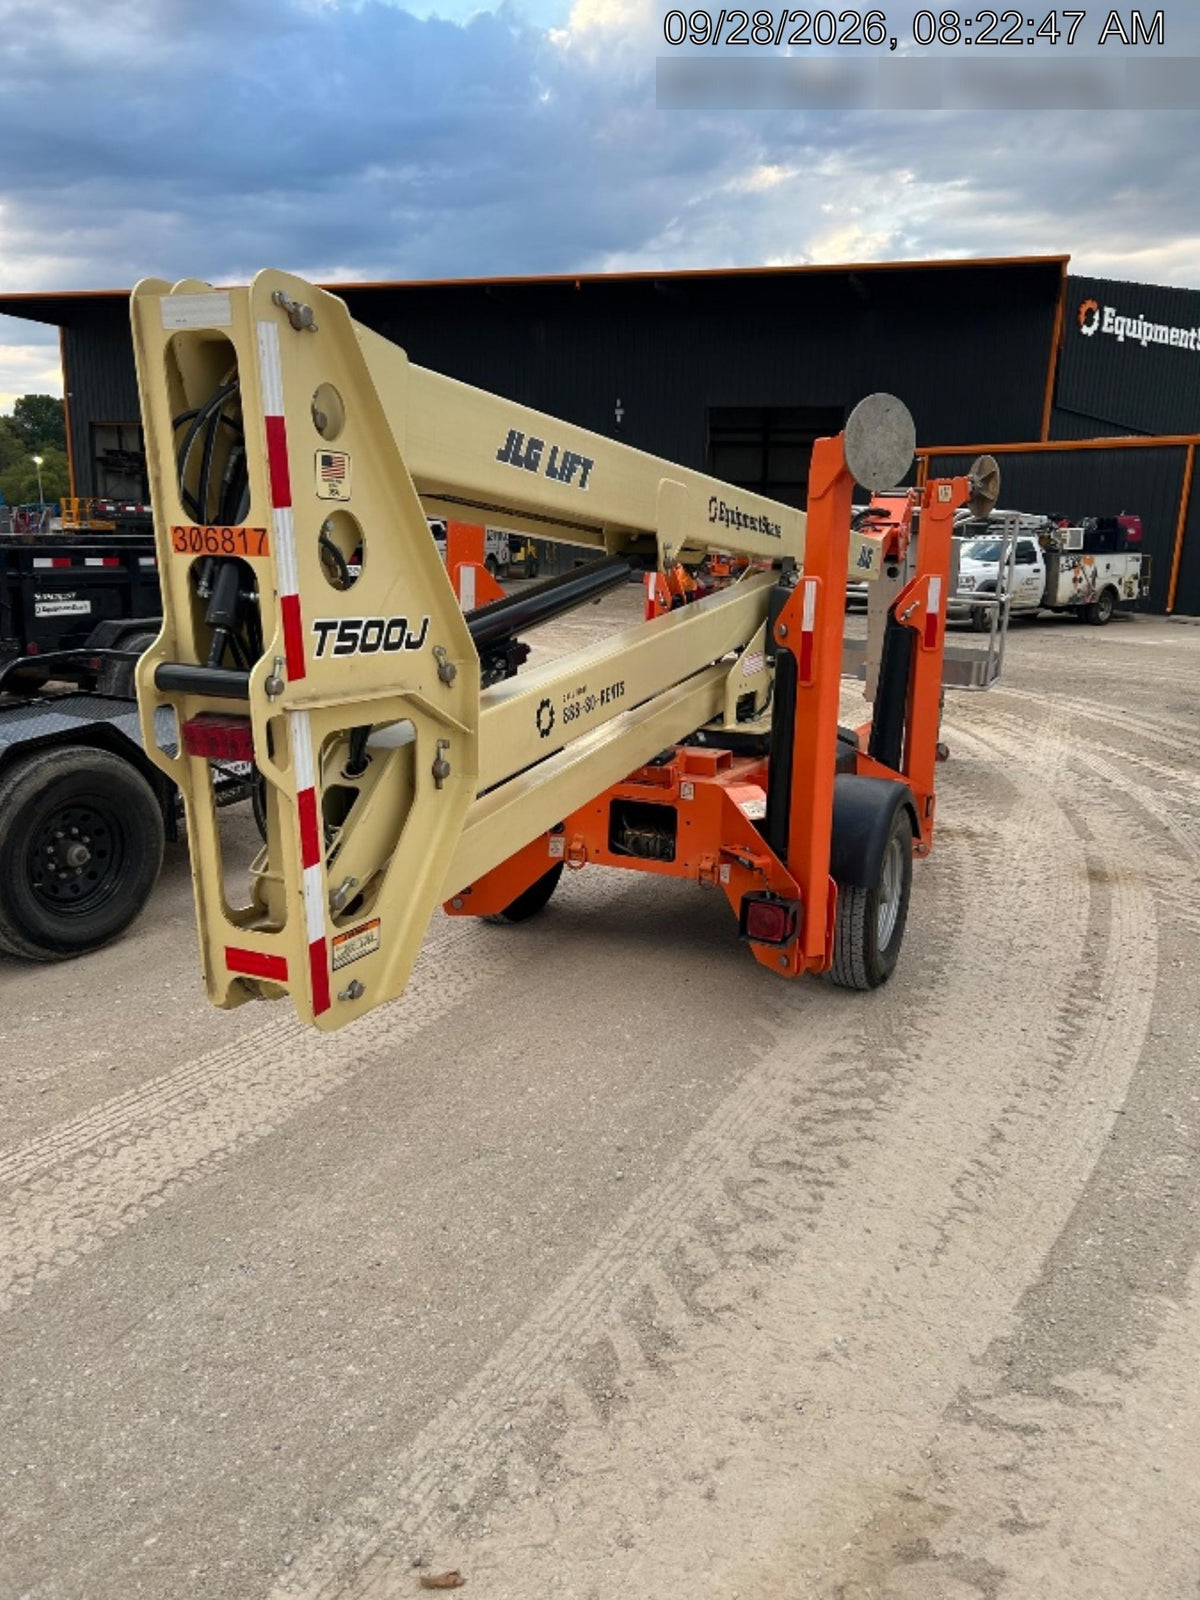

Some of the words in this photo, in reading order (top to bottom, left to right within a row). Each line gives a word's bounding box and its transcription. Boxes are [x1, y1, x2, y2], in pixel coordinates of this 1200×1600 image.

[495, 428, 546, 475] JLG
[544, 445, 595, 491] LIFT
[173, 526, 267, 555] 306817
[311, 615, 431, 660] T500J
